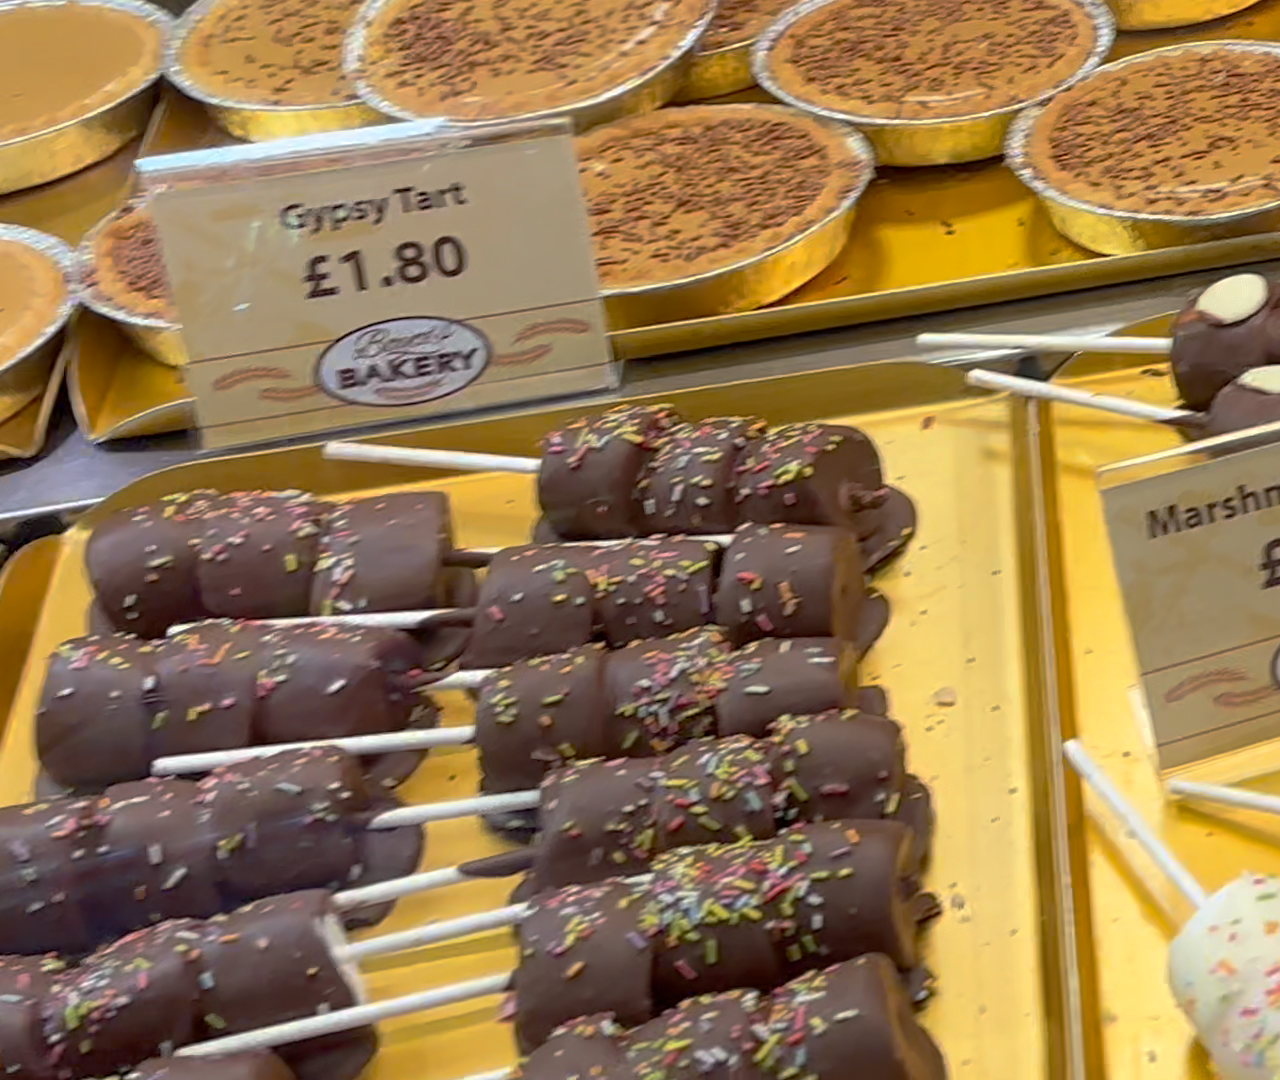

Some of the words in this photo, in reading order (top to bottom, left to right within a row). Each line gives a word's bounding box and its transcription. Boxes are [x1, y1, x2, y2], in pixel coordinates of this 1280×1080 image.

[278, 191, 391, 236] Gypsy
[393, 180, 469, 216] Tart
[303, 234, 470, 301] £1.80
[335, 347, 480, 390] BAKERY
